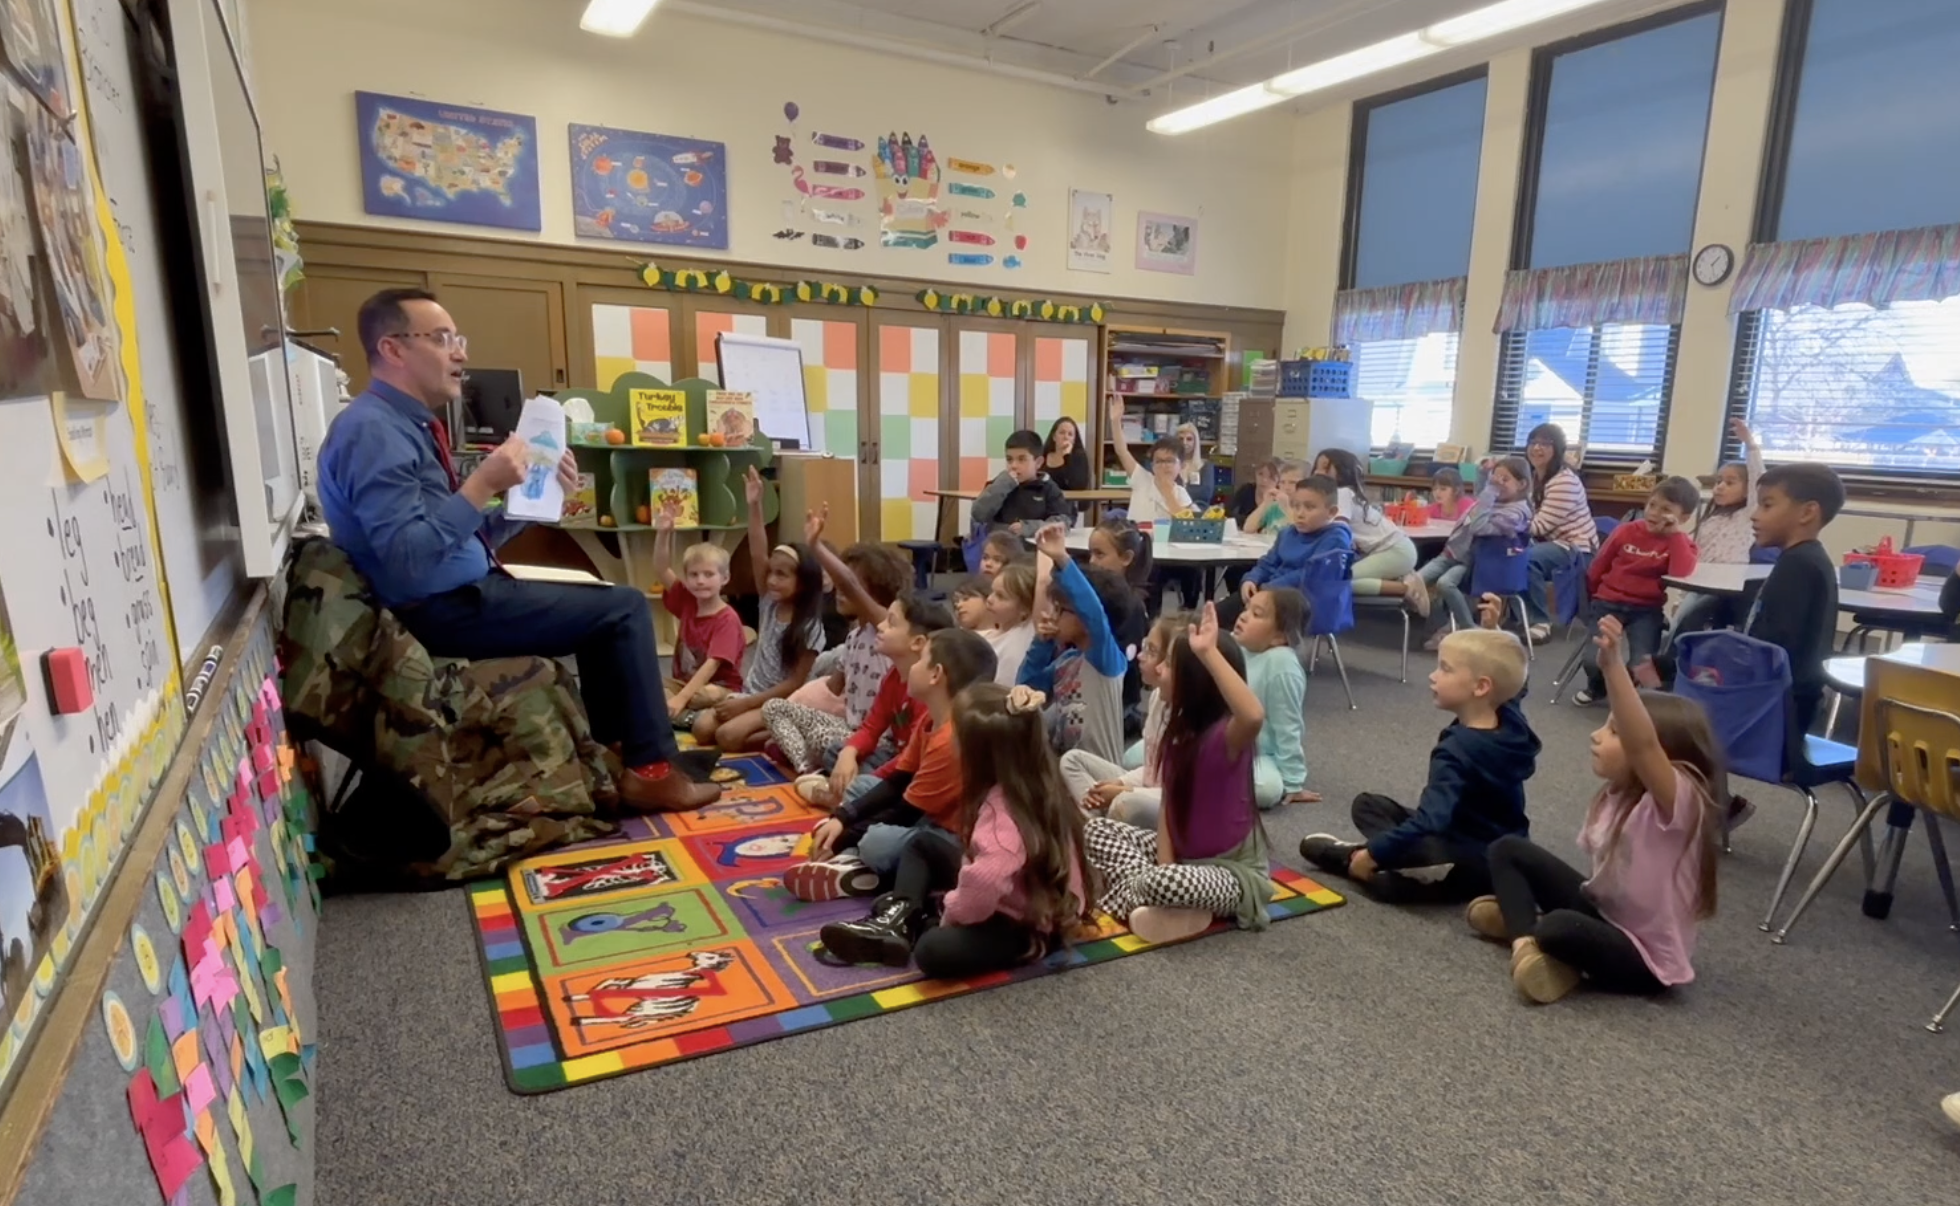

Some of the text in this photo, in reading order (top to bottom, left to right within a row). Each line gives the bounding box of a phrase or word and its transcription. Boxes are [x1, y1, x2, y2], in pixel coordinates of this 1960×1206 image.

[638, 391, 676, 405] Turkey
[647, 402, 683, 412] Trouble
[52, 487, 89, 587] leg
[64, 569, 102, 652] beg
[94, 701, 121, 753] hen
